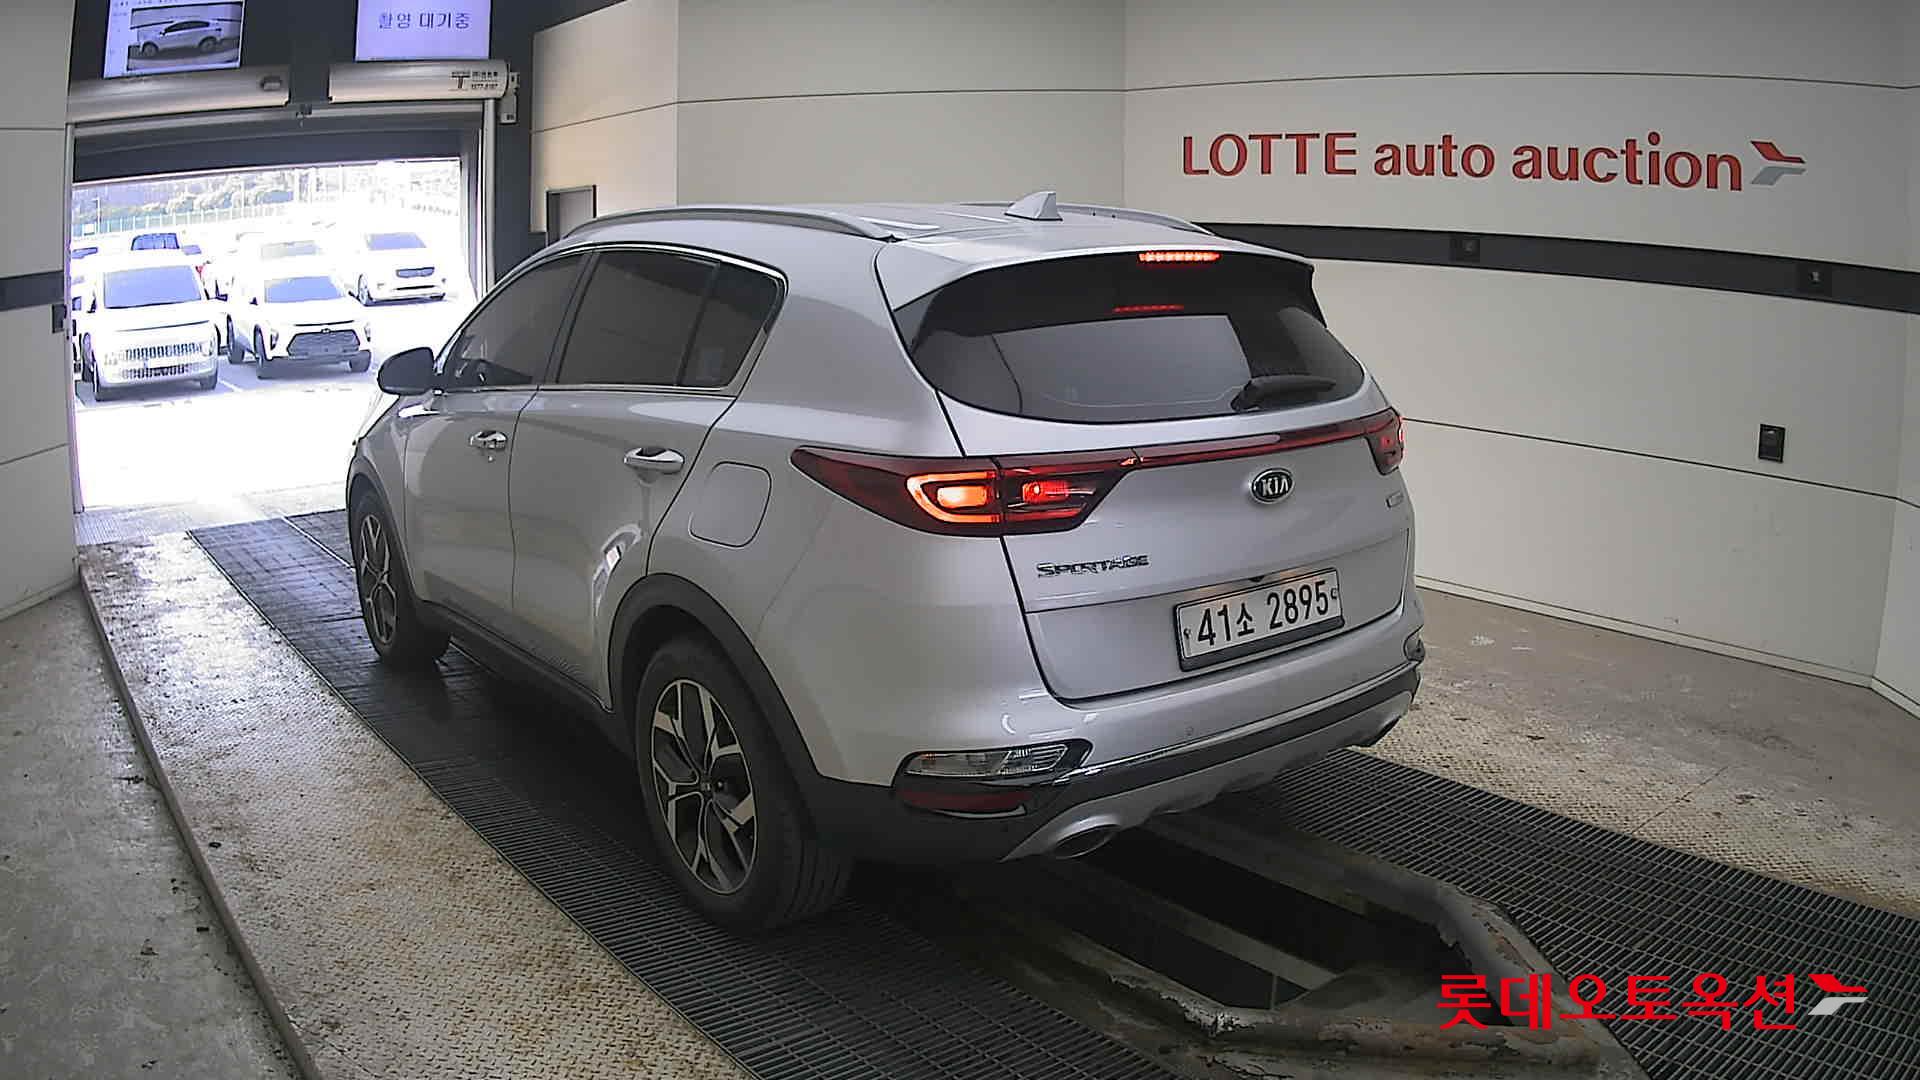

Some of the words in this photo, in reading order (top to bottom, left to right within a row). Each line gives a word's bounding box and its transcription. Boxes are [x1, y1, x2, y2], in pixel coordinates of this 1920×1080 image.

[418, 11, 471, 30] 대기중
[1181, 131, 1358, 177] LOTTE
[1373, 134, 1496, 178] auto
[1512, 131, 1744, 192] auction
[1036, 554, 1150, 579] SPORTAGE
[1197, 602, 1256, 647] 41소
[1266, 579, 1330, 630] 2895
